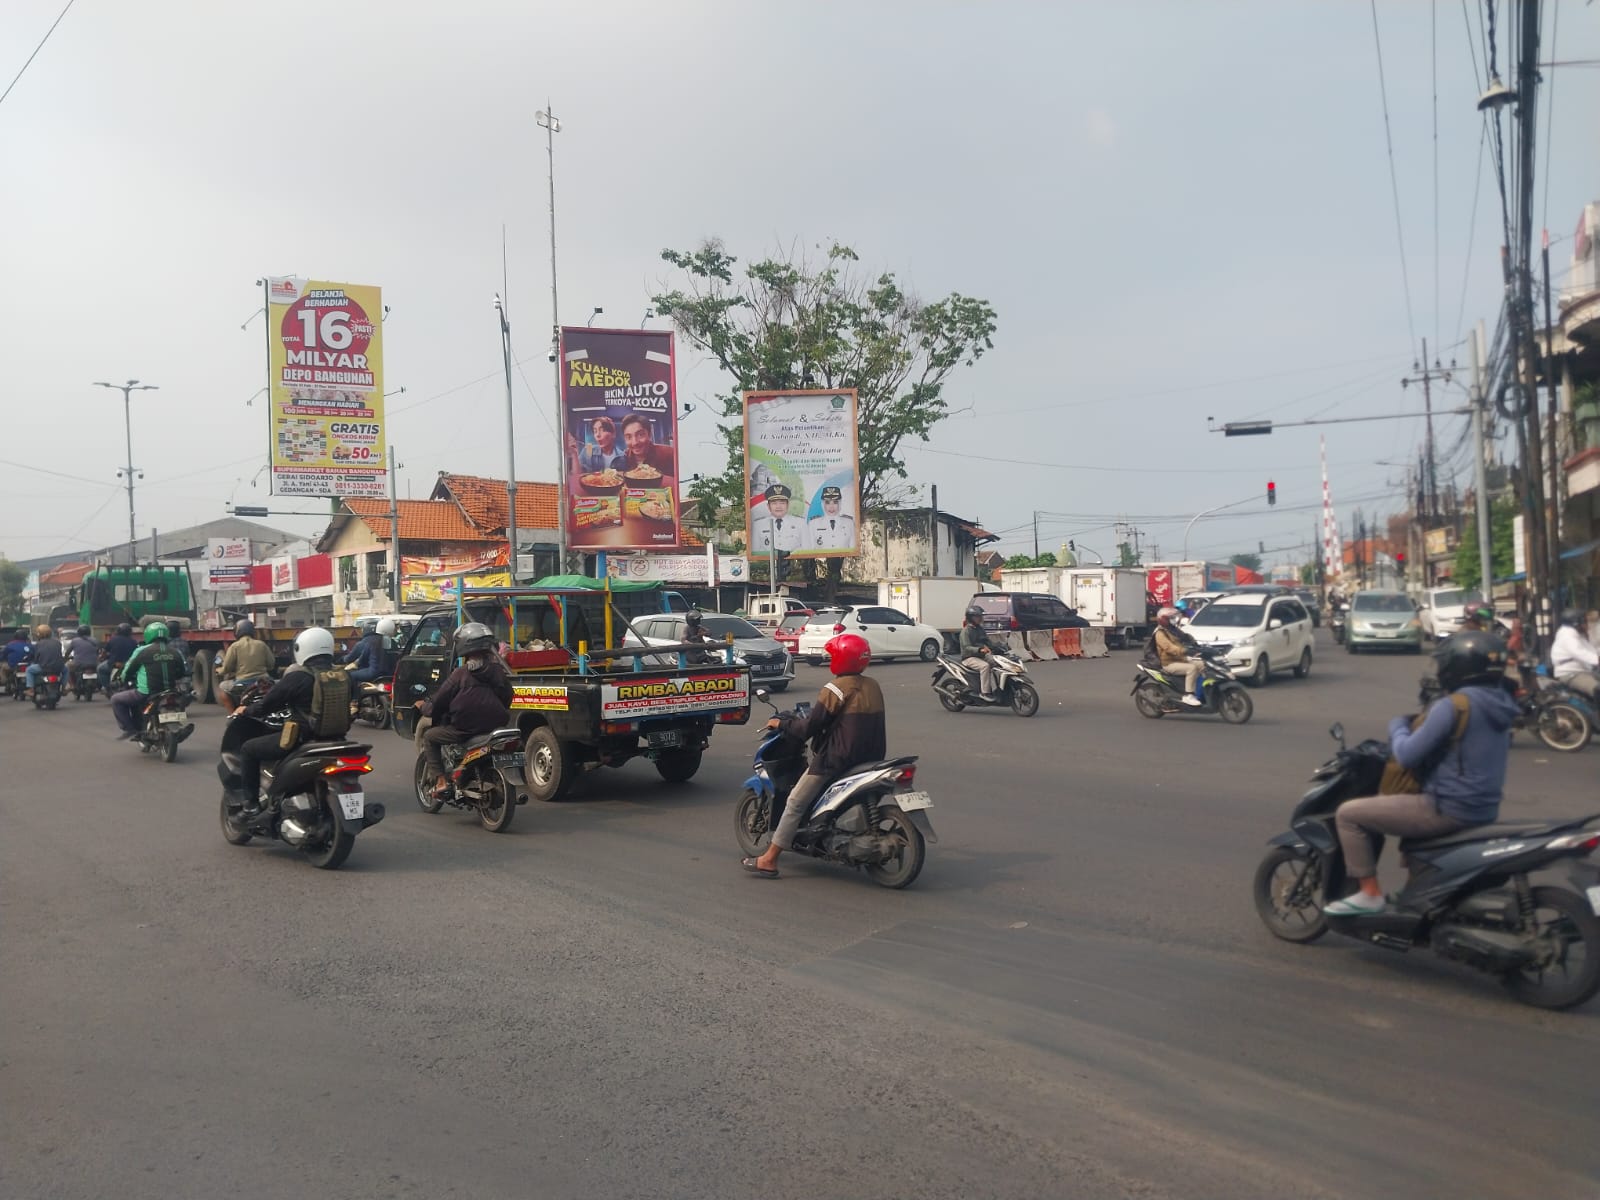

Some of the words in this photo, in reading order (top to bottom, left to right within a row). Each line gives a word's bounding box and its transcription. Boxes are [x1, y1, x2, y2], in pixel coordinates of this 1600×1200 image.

[310, 290, 344, 298] BELANJA
[304, 298, 348, 307] BERHADIAH
[297, 309, 353, 350] 16
[287, 349, 367, 369] MILYAR
[283, 368, 312, 381] DEPO
[314, 370, 373, 384] BANGUNAN
[570, 360, 609, 374] KUAH
[611, 368, 631, 378] KOYA
[569, 372, 631, 387] MEDOK
[604, 387, 624, 399] BIKIN
[626, 381, 668, 397] AUTO
[605, 397, 668, 408] TERKOYA-KOYA
[799, 414, 808, 423] &
[331, 423, 379, 434] GRATIS
[352, 447, 370, 459] 50
[534, 688, 565, 697] ABADI
[618, 682, 678, 700] RIMBA
[680, 678, 736, 696] ABADI
[627, 700, 650, 708] KAYU,
[699, 692, 745, 701] SCAFFOLDING
